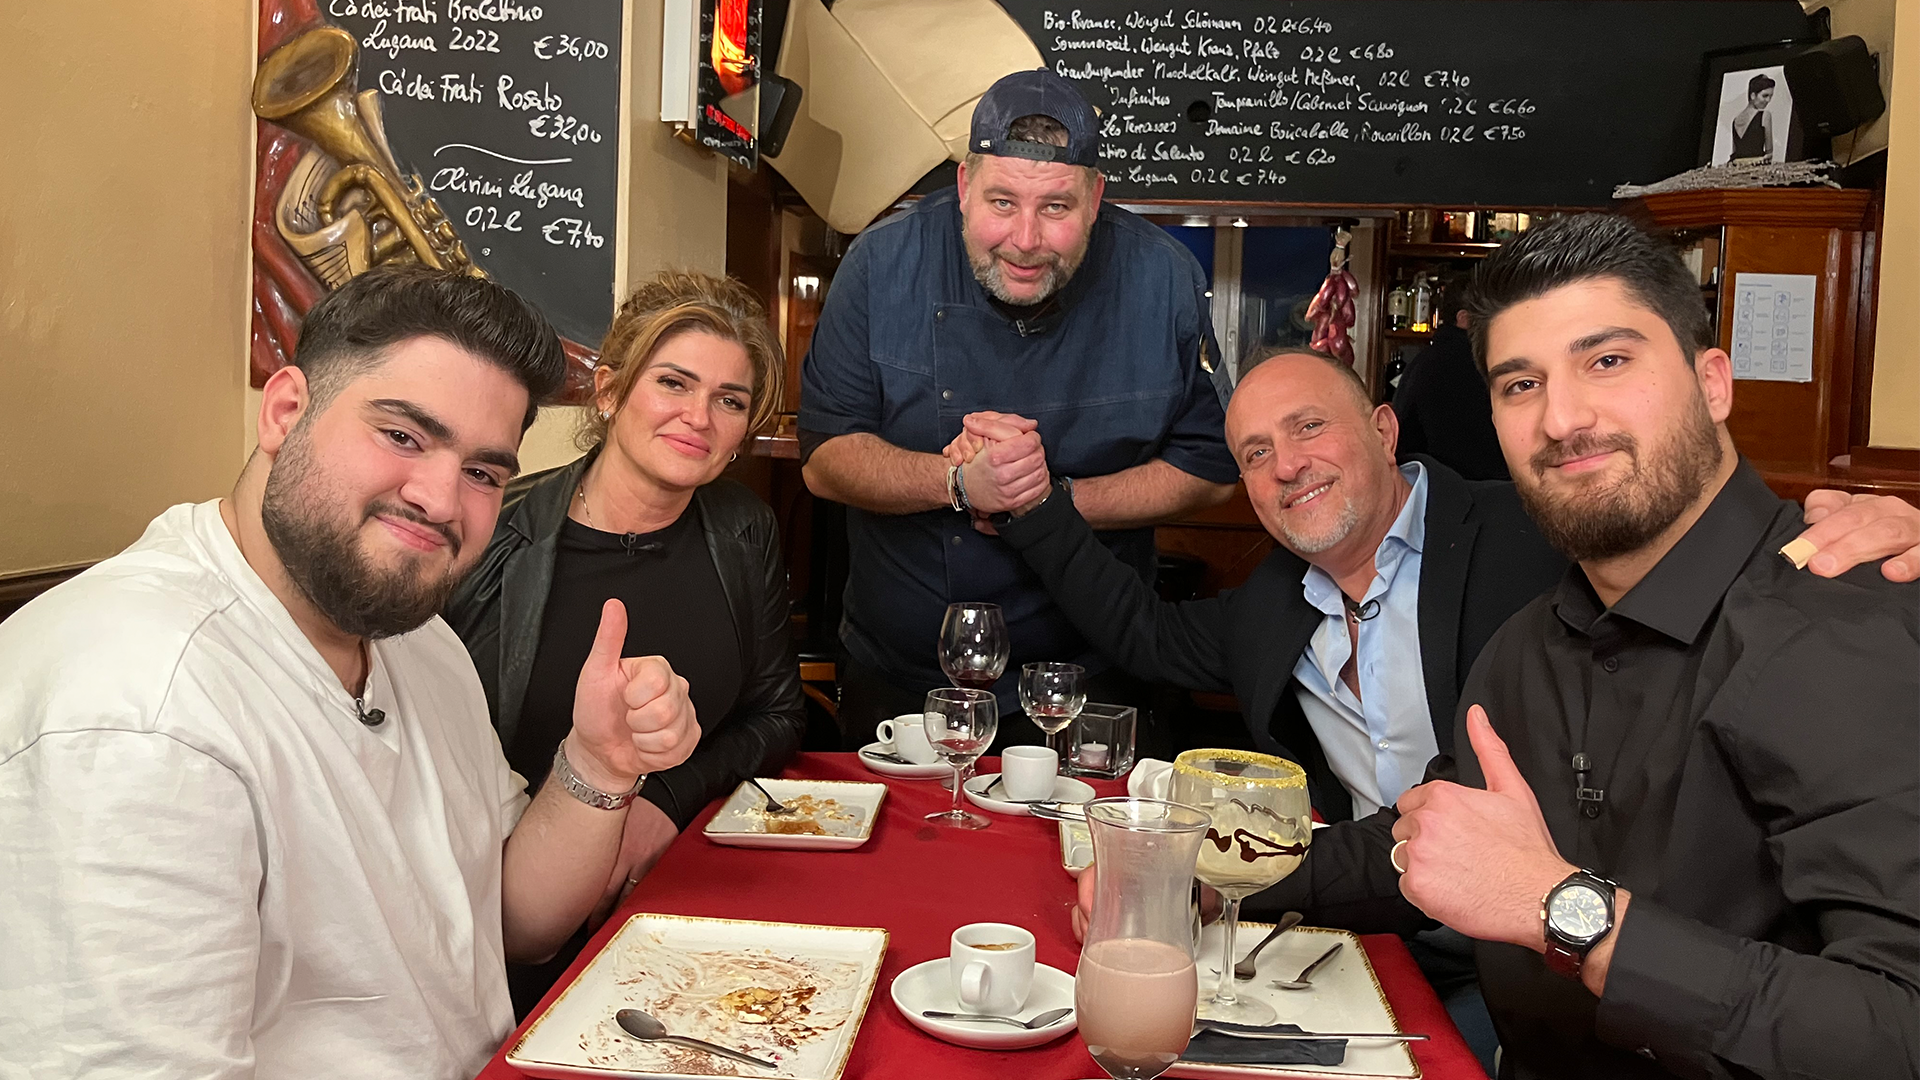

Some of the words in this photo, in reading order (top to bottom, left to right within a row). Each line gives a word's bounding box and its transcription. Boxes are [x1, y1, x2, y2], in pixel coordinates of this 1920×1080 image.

[1125, 9, 1175, 33] Weingut
[362, 19, 438, 59] Lugana
[448, 26, 501, 53] 2022
[1141, 34, 1192, 59] Weingut
[1243, 38, 1281, 65] Pfalz
[1248, 64, 1299, 89] Weingut
[440, 73, 485, 103] Frati
[497, 74, 562, 111] Rosato
[1358, 92, 1428, 117] Sauvignon
[1205, 119, 1263, 136] Domaine
[1131, 143, 1147, 160] di
[1152, 141, 1205, 161] Salento
[430, 166, 503, 199] Olivini
[508, 169, 584, 208] Lugana
[1128, 165, 1178, 187] Lugana
[541, 217, 605, 249] €7,40
